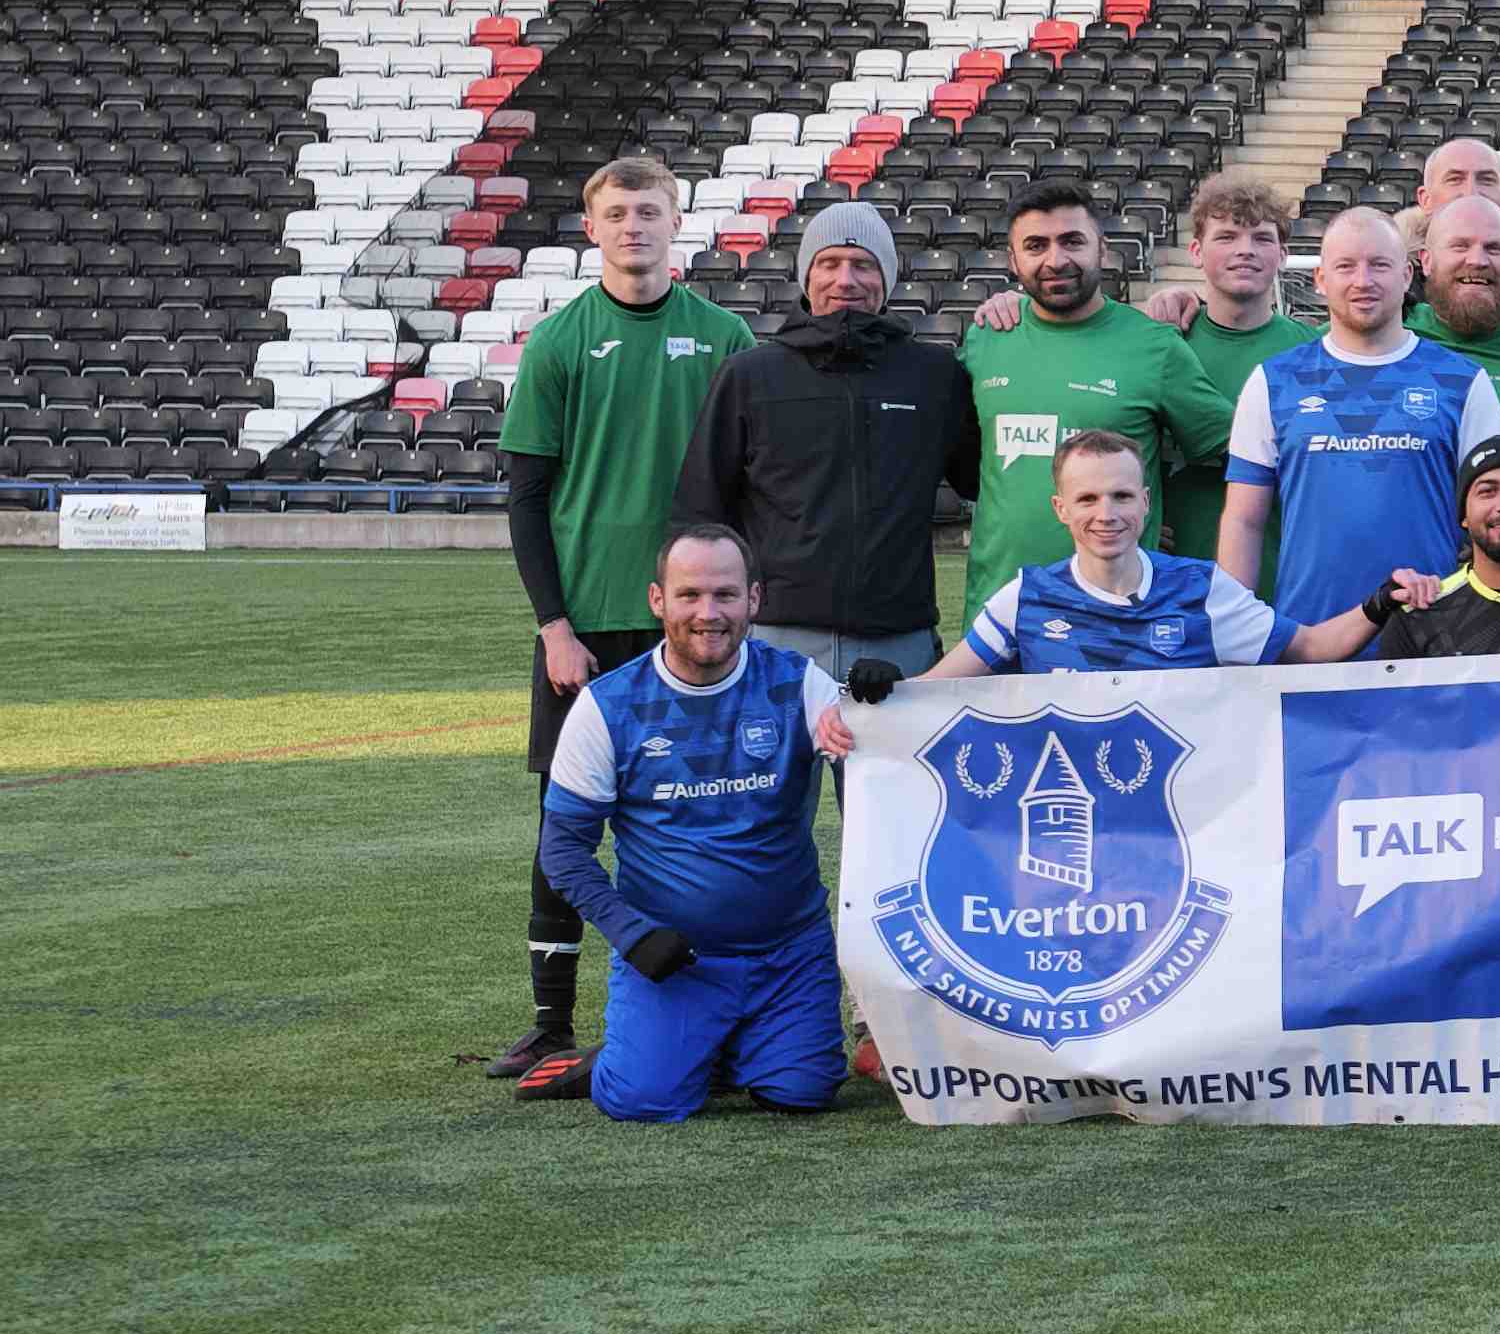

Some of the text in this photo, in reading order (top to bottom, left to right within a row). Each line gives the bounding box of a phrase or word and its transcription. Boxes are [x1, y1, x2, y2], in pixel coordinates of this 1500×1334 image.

[1002, 426, 1049, 443] TALK
[1327, 434, 1429, 451] AutoTrader
[673, 772, 777, 800] AutoTrader
[1352, 819, 1465, 859] TALK
[962, 893, 1147, 937] Everton
[896, 925, 1211, 1030] NIL SATIS NISI OPTIMUM
[1025, 948, 1084, 973] 1878
[890, 1064, 1148, 1106] SUPPORTING
[1160, 1067, 1290, 1105] MEN'S
[1303, 1060, 1472, 1098] MENTAL
